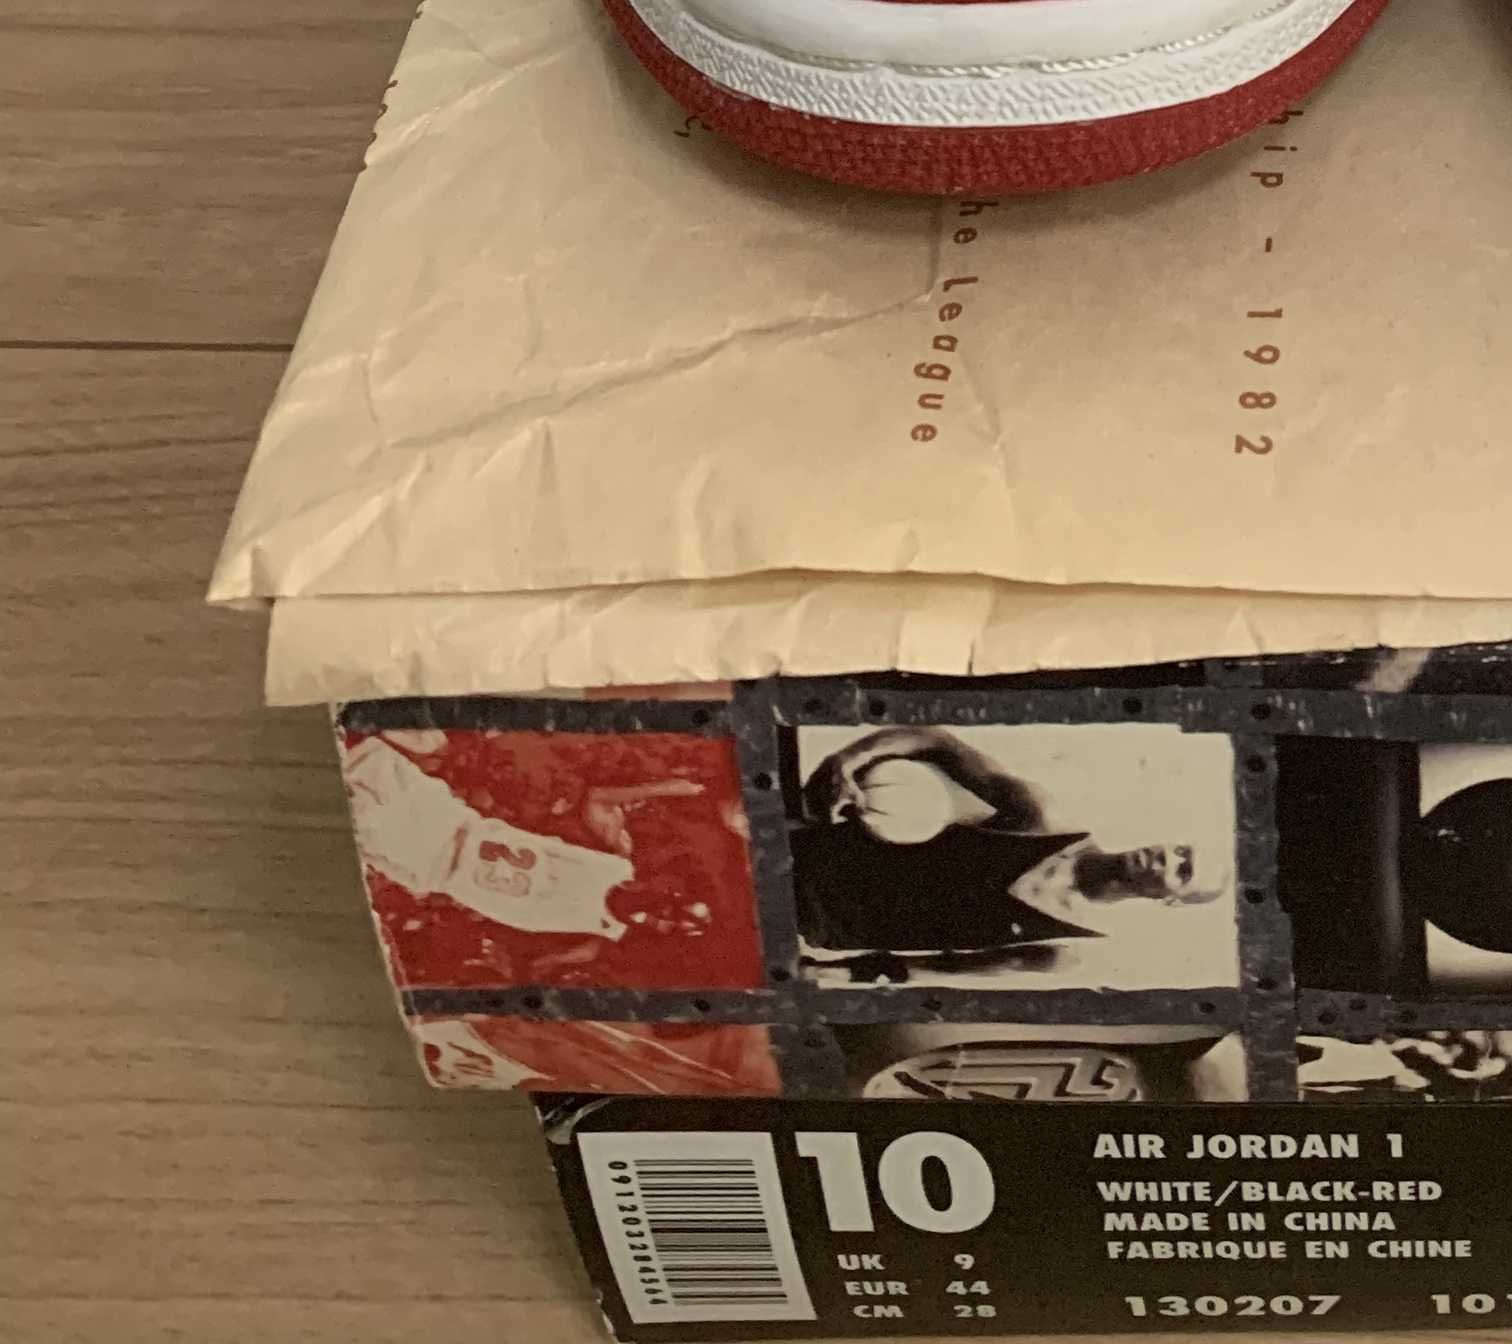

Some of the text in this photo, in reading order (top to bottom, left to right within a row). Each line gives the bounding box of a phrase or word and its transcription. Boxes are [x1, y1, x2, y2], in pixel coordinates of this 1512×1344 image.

[911, 274, 980, 445] League
[1233, 307, 1284, 456] 1982
[472, 839, 538, 898] 23
[1092, 1133, 1404, 1160] AIR JORDAN 1
[794, 1130, 996, 1234] 10
[1096, 1180, 1443, 1207] WHITE/BLACK-RED
[1103, 1212, 1397, 1232] MADE IN CHINA
[836, 1253, 976, 1271] UK 9
[1106, 1239, 1474, 1261] FABRIQUE EN CHINE
[844, 1280, 991, 1296] EUR 44
[852, 1304, 998, 1318] CM 28
[1124, 1294, 1342, 1318] 130207
